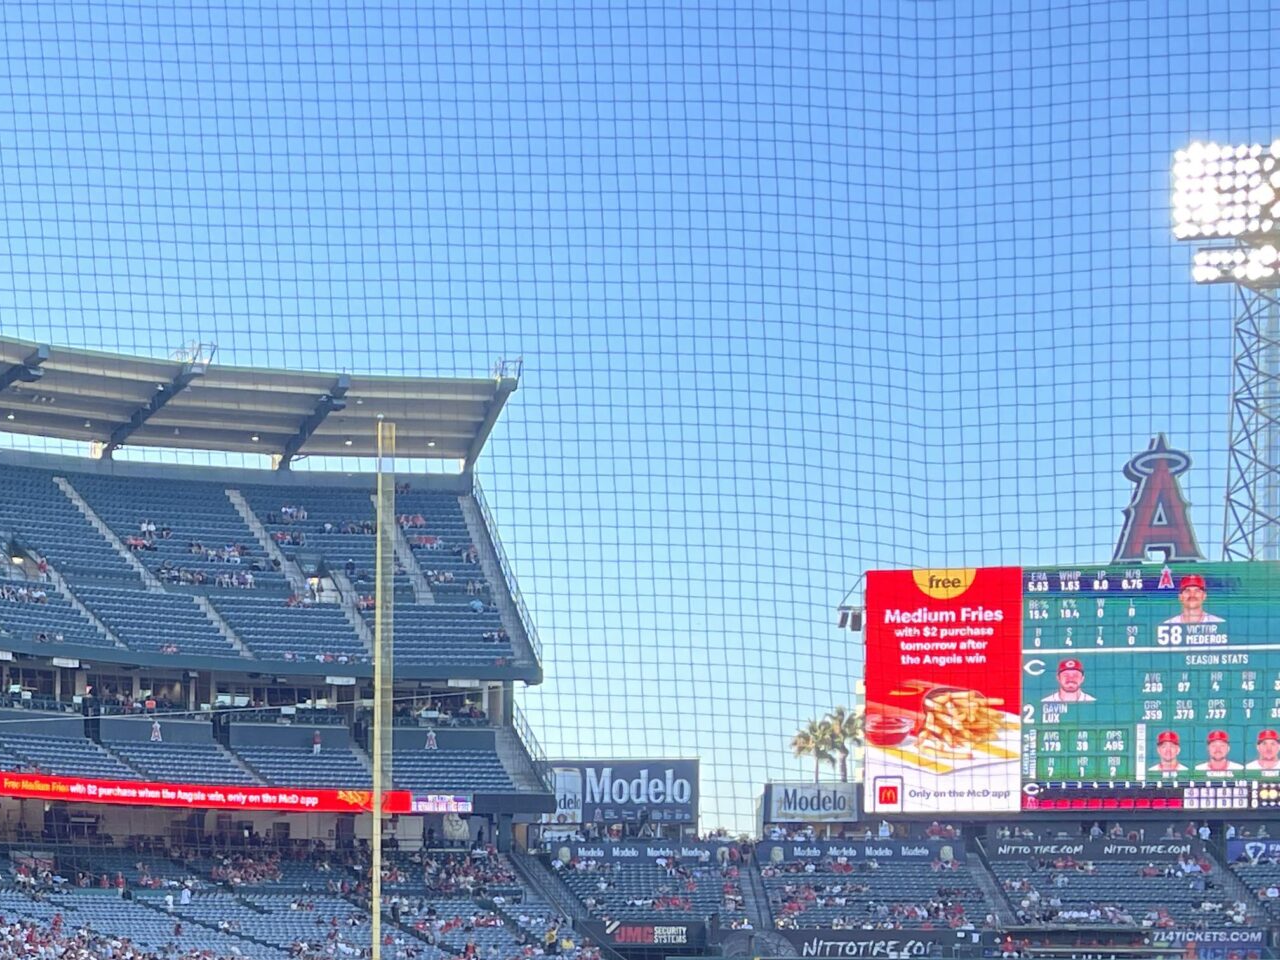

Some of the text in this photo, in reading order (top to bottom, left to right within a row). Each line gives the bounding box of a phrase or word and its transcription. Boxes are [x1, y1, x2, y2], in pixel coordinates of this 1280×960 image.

[1059, 571, 1081, 580] WHIP
[929, 575, 961, 588] free
[884, 606, 1004, 623] Medium Fries
[895, 626, 994, 638] with $2 purchase
[1157, 625, 1182, 645] 58
[1186, 625, 1217, 634] VICTOR
[900, 639, 988, 650] tomorrow after
[1186, 635, 1227, 644] MEDEROS
[901, 653, 986, 667] the Angels win
[1186, 654, 1248, 665] SEASON STATS
[1144, 673, 1161, 682] AVG
[1023, 704, 1035, 723] 2
[1043, 704, 1067, 713] GAVIN
[1042, 714, 1060, 723] LUX
[585, 767, 691, 804] Modelo
[783, 788, 846, 811] Modelo
[909, 789, 1010, 799] Only on the McD app
[578, 847, 639, 857] Modelo Modelo
[794, 846, 929, 857] Modelo Modelo Modelo Modelo
[998, 844, 1083, 854] NITTO TIRE.COM
[1104, 844, 1191, 854] NITTO TIRE.COM
[615, 926, 653, 943] JMG
[654, 926, 687, 935] SECURITY
[654, 935, 687, 944] SYSTEMS
[1153, 931, 1262, 942] 714TICKETS.COM
